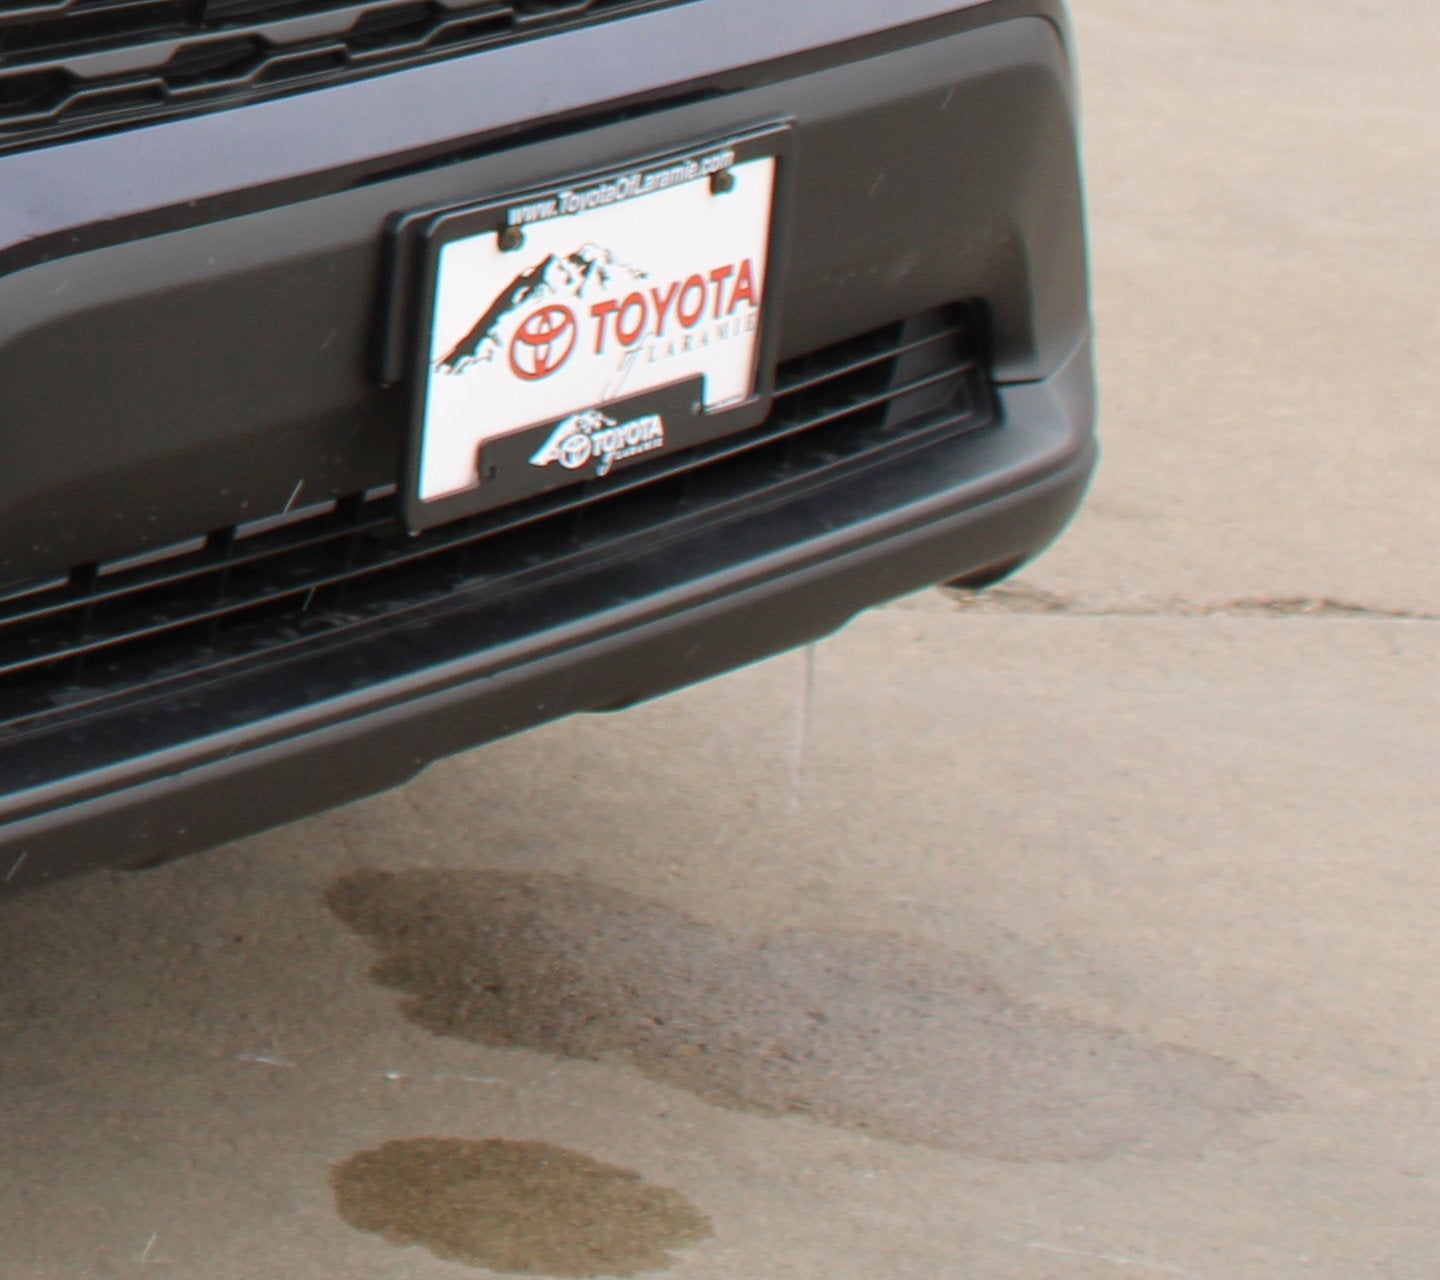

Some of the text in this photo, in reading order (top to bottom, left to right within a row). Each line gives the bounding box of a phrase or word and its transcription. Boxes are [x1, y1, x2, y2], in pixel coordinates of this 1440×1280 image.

[508, 150, 735, 226] www.ToyotaOfLaramie.com
[590, 258, 758, 355] TOYOTA
[590, 413, 664, 458] TOYOTA
